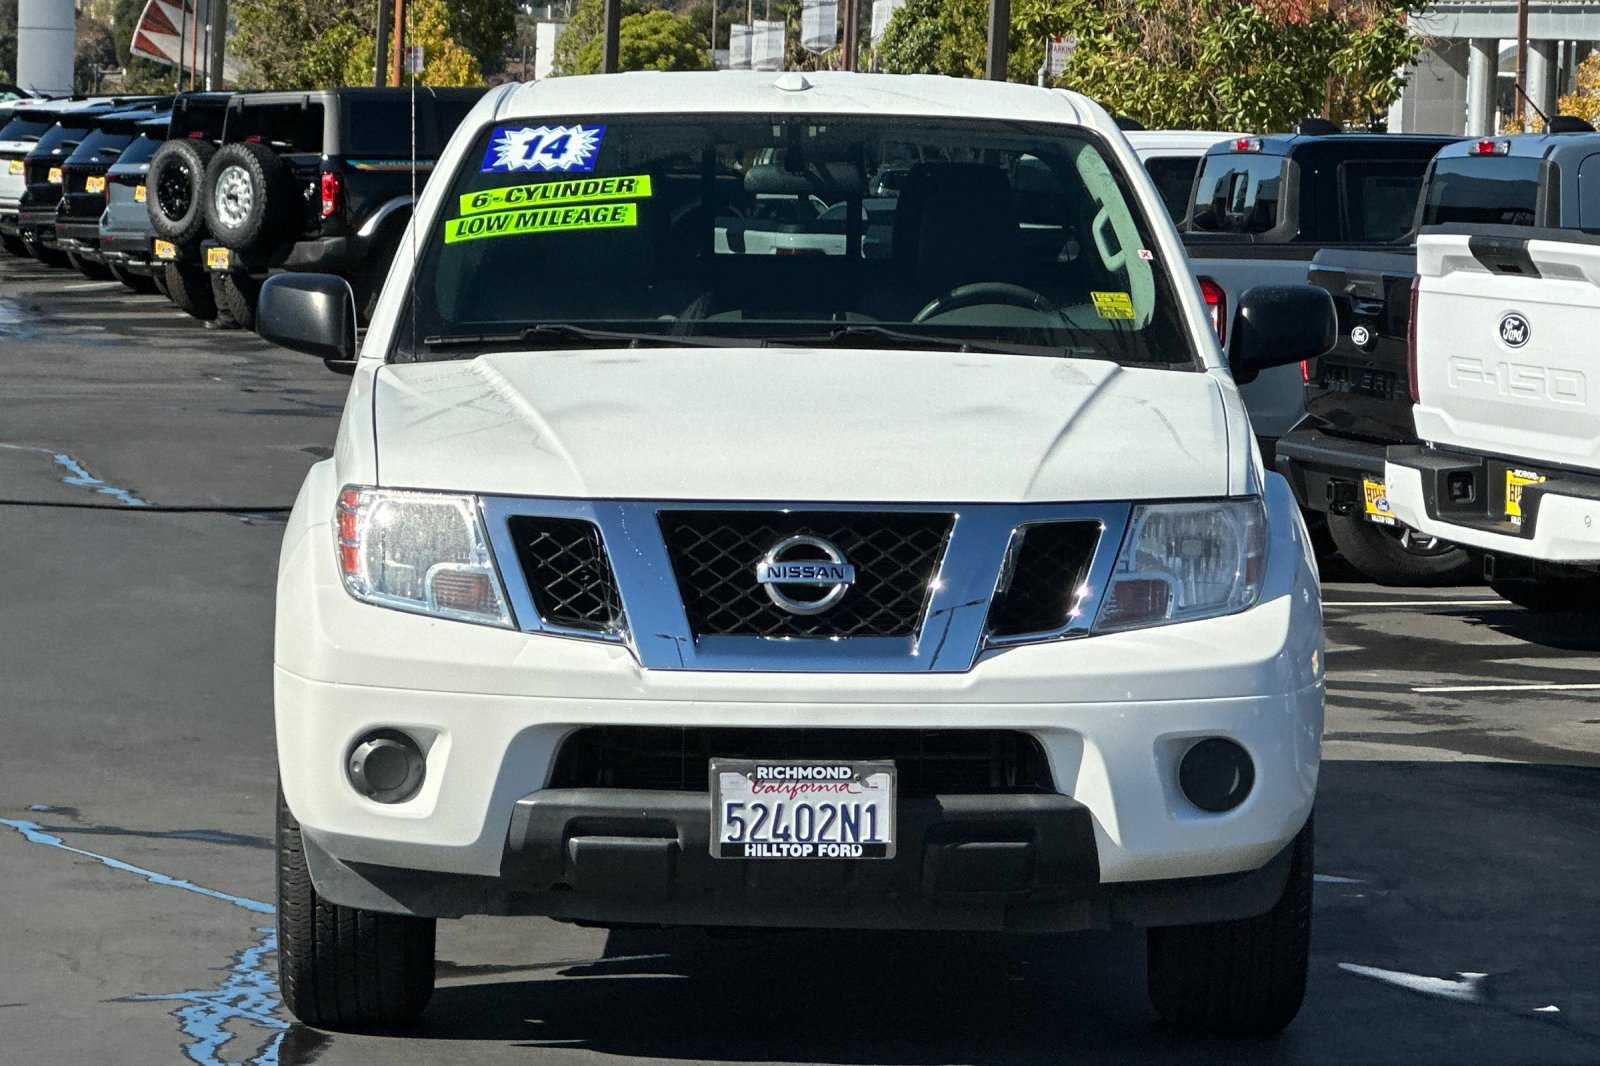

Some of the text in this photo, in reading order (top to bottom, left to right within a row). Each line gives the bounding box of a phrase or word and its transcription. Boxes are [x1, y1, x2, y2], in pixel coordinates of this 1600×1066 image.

[522, 134, 573, 160] 14
[455, 206, 629, 238] LOW MILEAGE
[1502, 318, 1525, 342] Ford
[1448, 355, 1587, 406] F-150
[767, 566, 844, 579] NISSAN
[756, 766, 852, 779] RICHMOND
[751, 778, 863, 800] California
[726, 802, 883, 842] 52402N1
[744, 844, 863, 857] HILLTOP FORD
